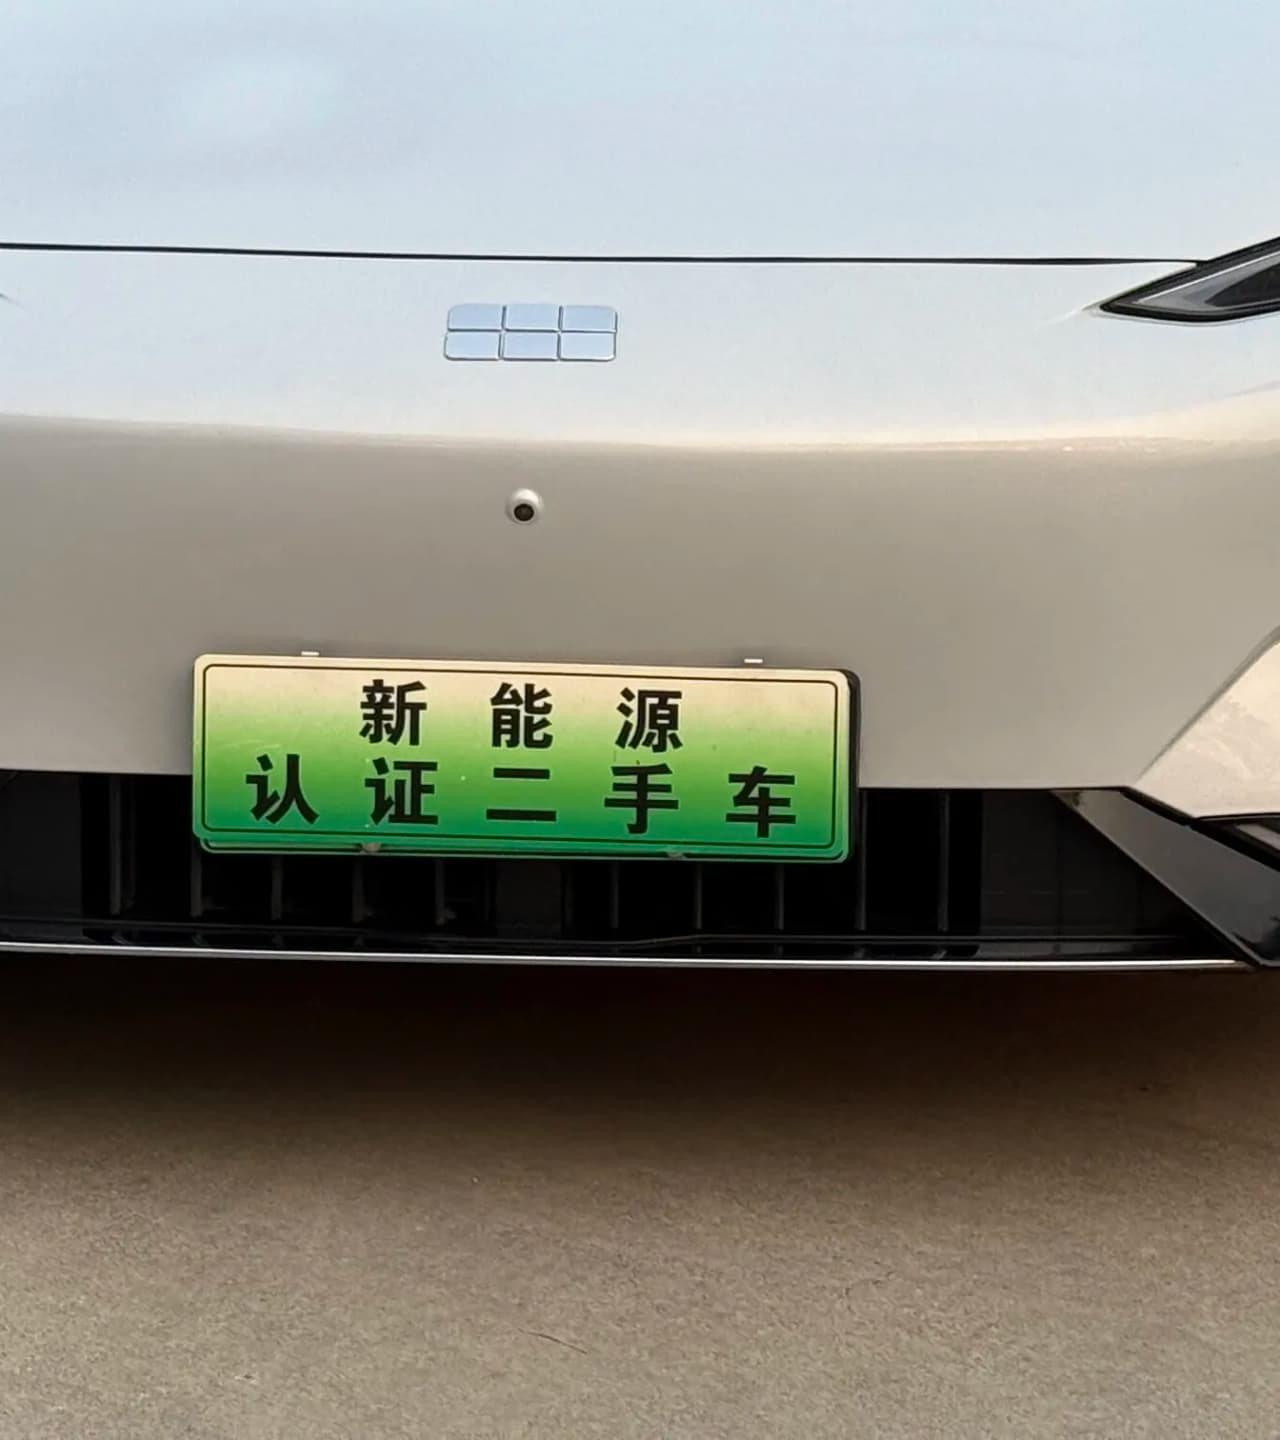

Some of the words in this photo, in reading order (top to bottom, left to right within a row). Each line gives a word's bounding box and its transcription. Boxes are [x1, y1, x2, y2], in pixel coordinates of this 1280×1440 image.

[359, 678, 684, 753] 新能源
[245, 753, 797, 839] 认证二手车
